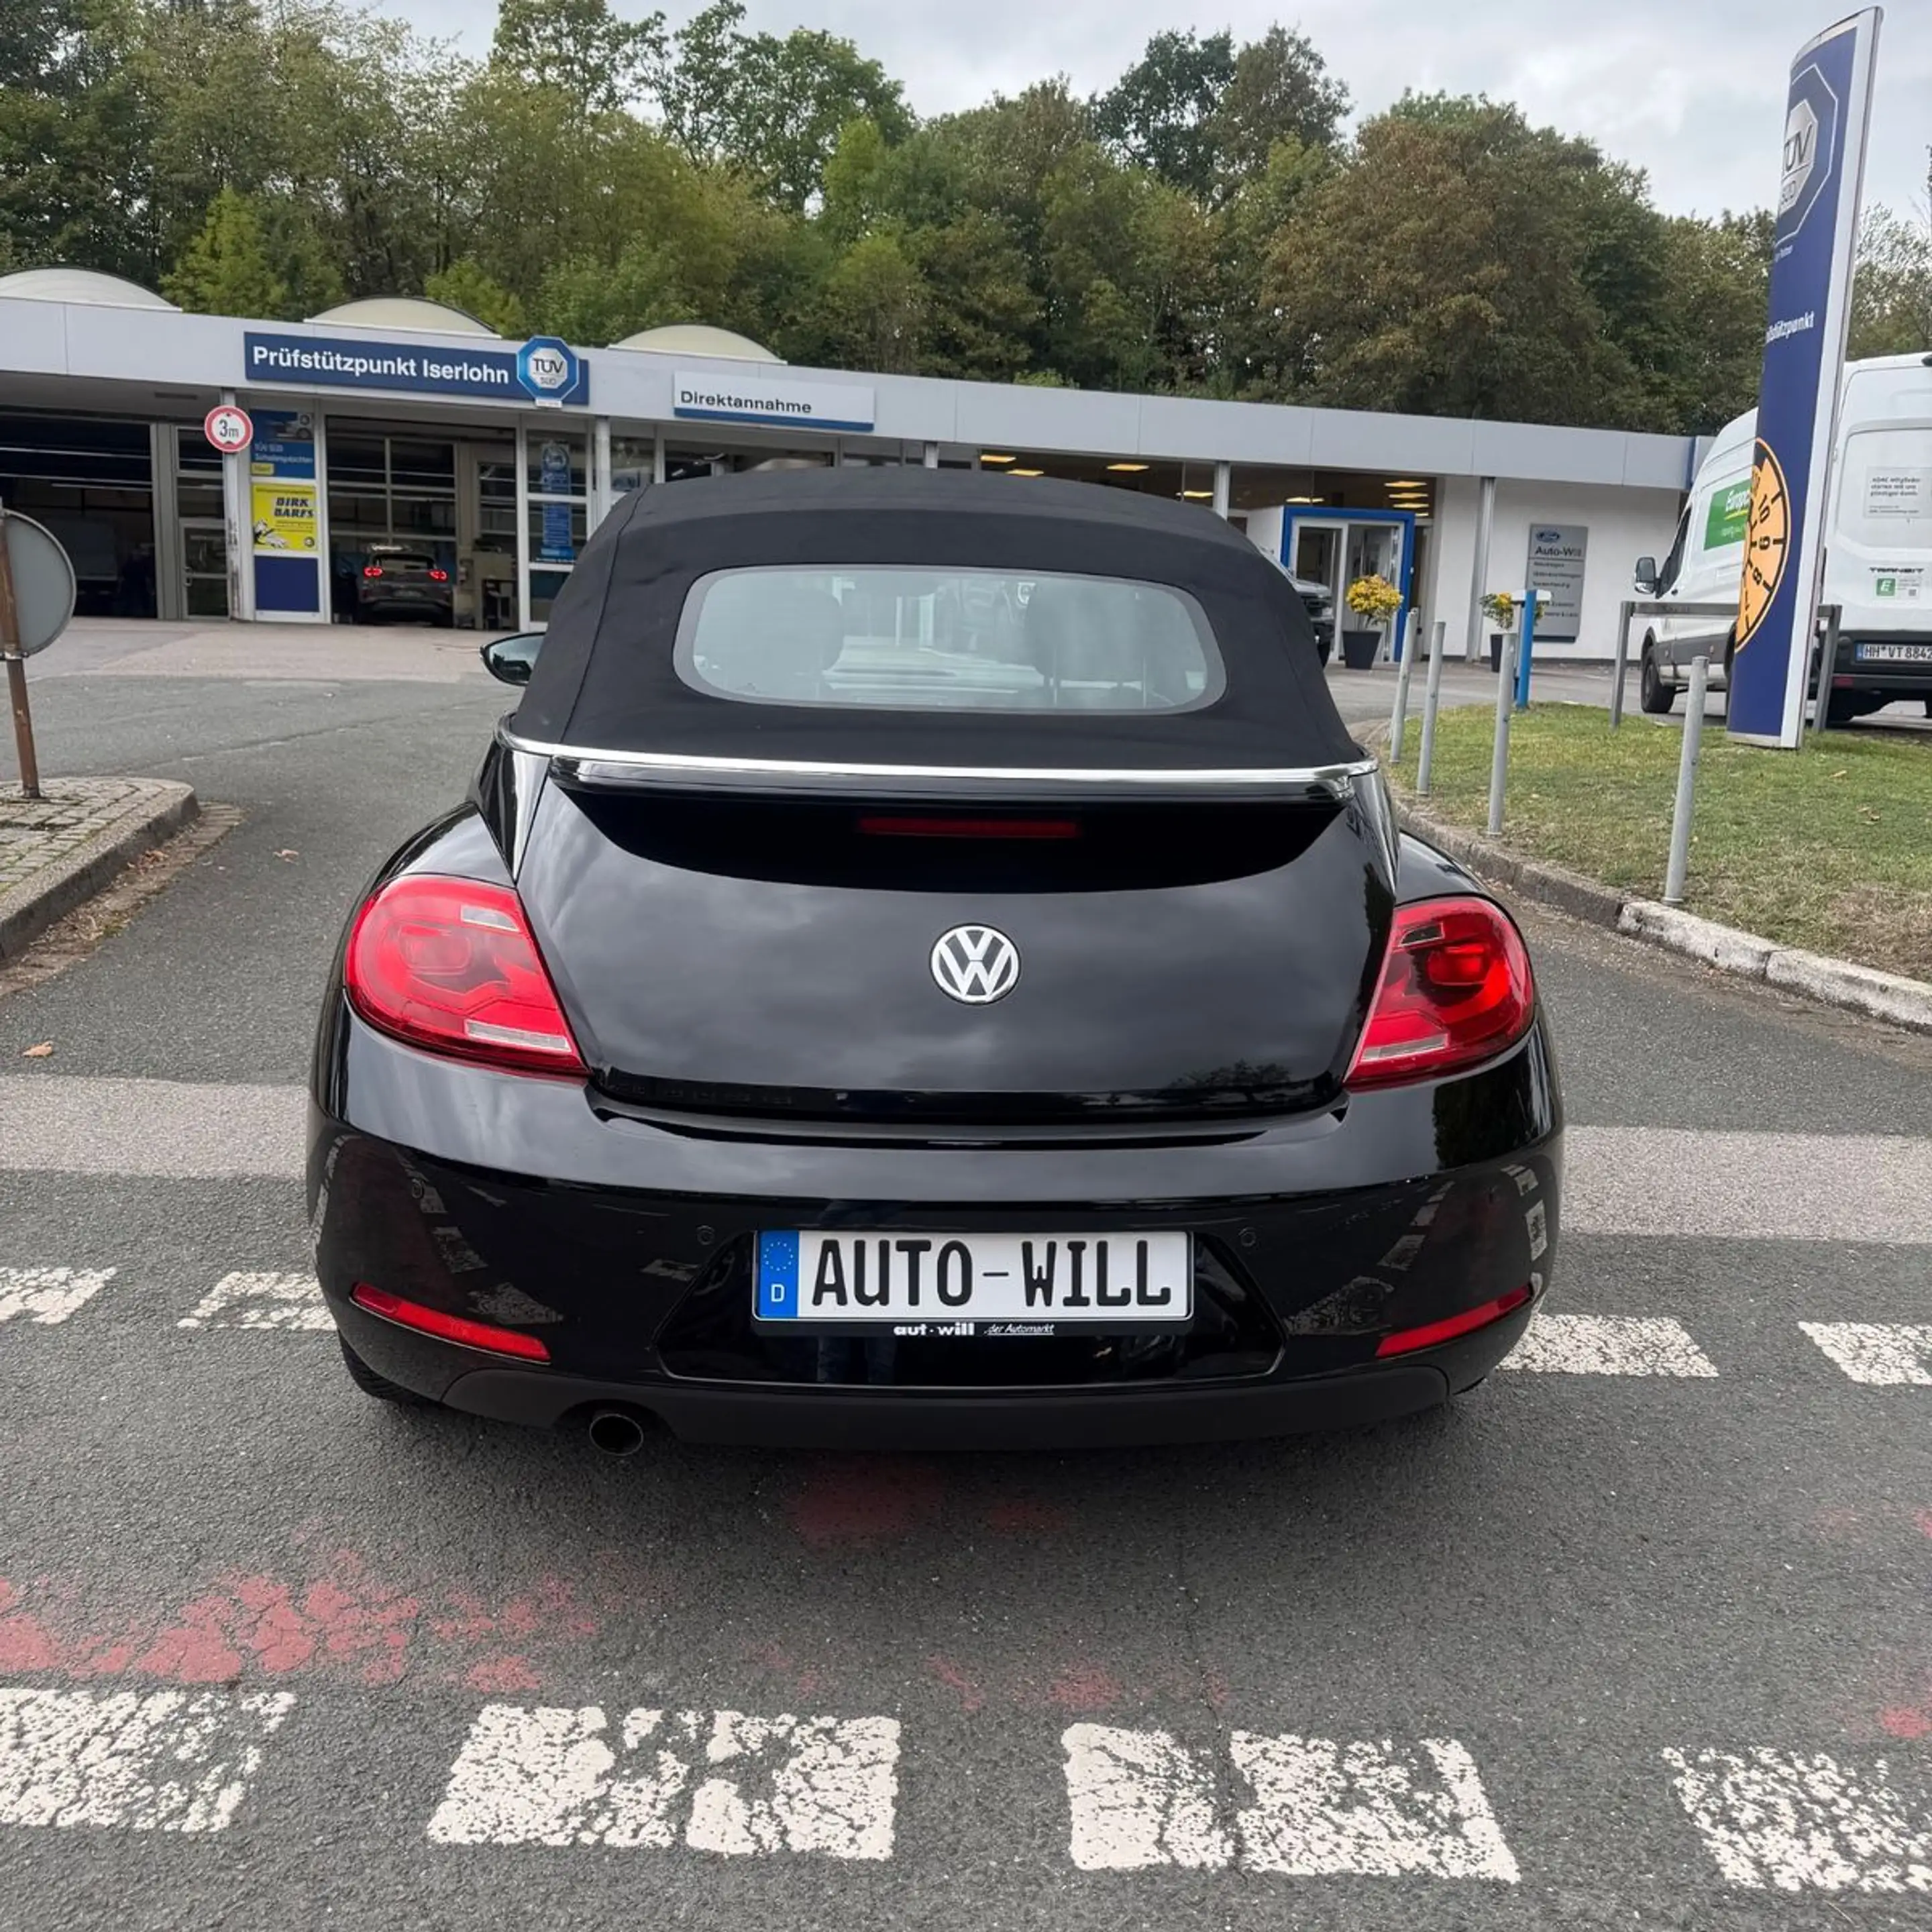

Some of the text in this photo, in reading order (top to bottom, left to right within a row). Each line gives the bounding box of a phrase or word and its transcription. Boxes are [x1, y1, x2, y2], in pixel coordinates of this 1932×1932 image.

[253, 346, 509, 383] Prüfstützpunkt Iserlohn
[533, 358, 564, 374] TÜV
[680, 391, 812, 413] Direktannahme
[276, 496, 309, 507] DIRK
[771, 1283, 784, 1303] D
